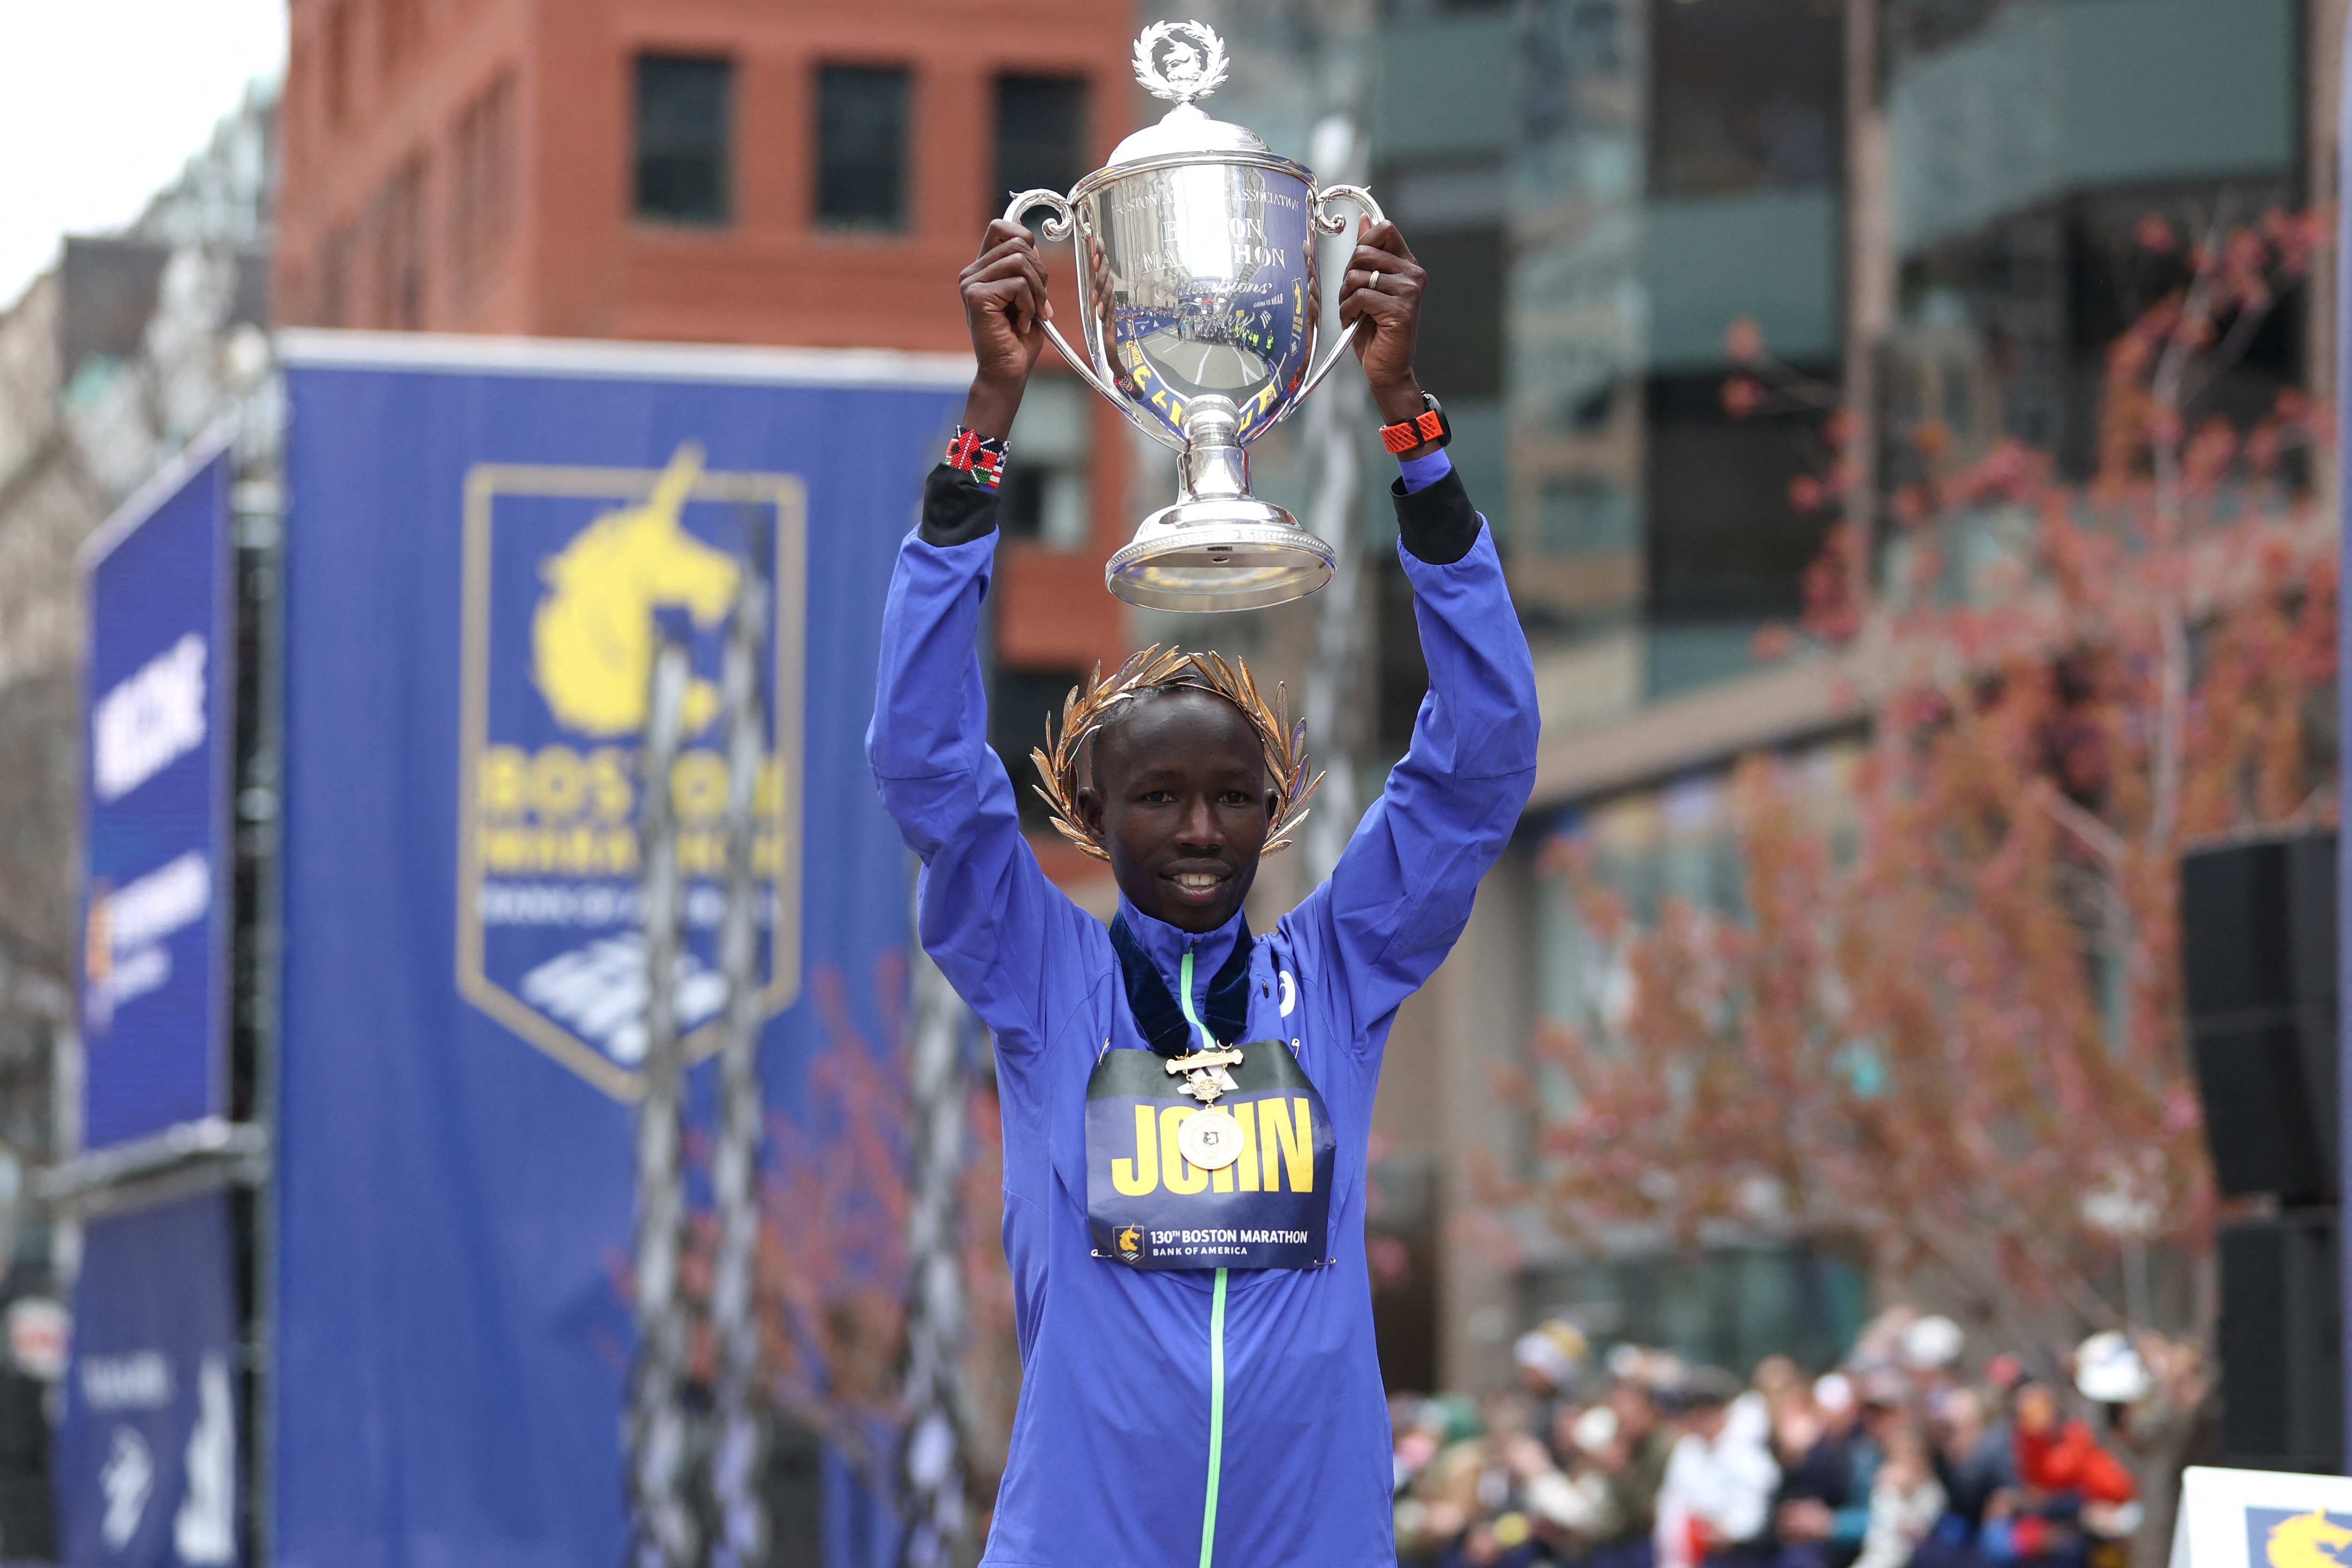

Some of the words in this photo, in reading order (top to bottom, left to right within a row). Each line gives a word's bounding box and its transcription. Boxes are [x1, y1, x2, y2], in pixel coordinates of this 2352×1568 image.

[1233, 189, 1300, 211] ASSOCIATION
[1112, 1098, 1313, 1196] JOHN
[1150, 1230, 1180, 1244] 130TH
[1182, 1229, 1237, 1243] BOSTON
[1240, 1230, 1308, 1243] MARATHON
[1153, 1247, 1182, 1256] BANK
[1185, 1247, 1198, 1255] OF
[1200, 1246, 1247, 1255] AMERICA
